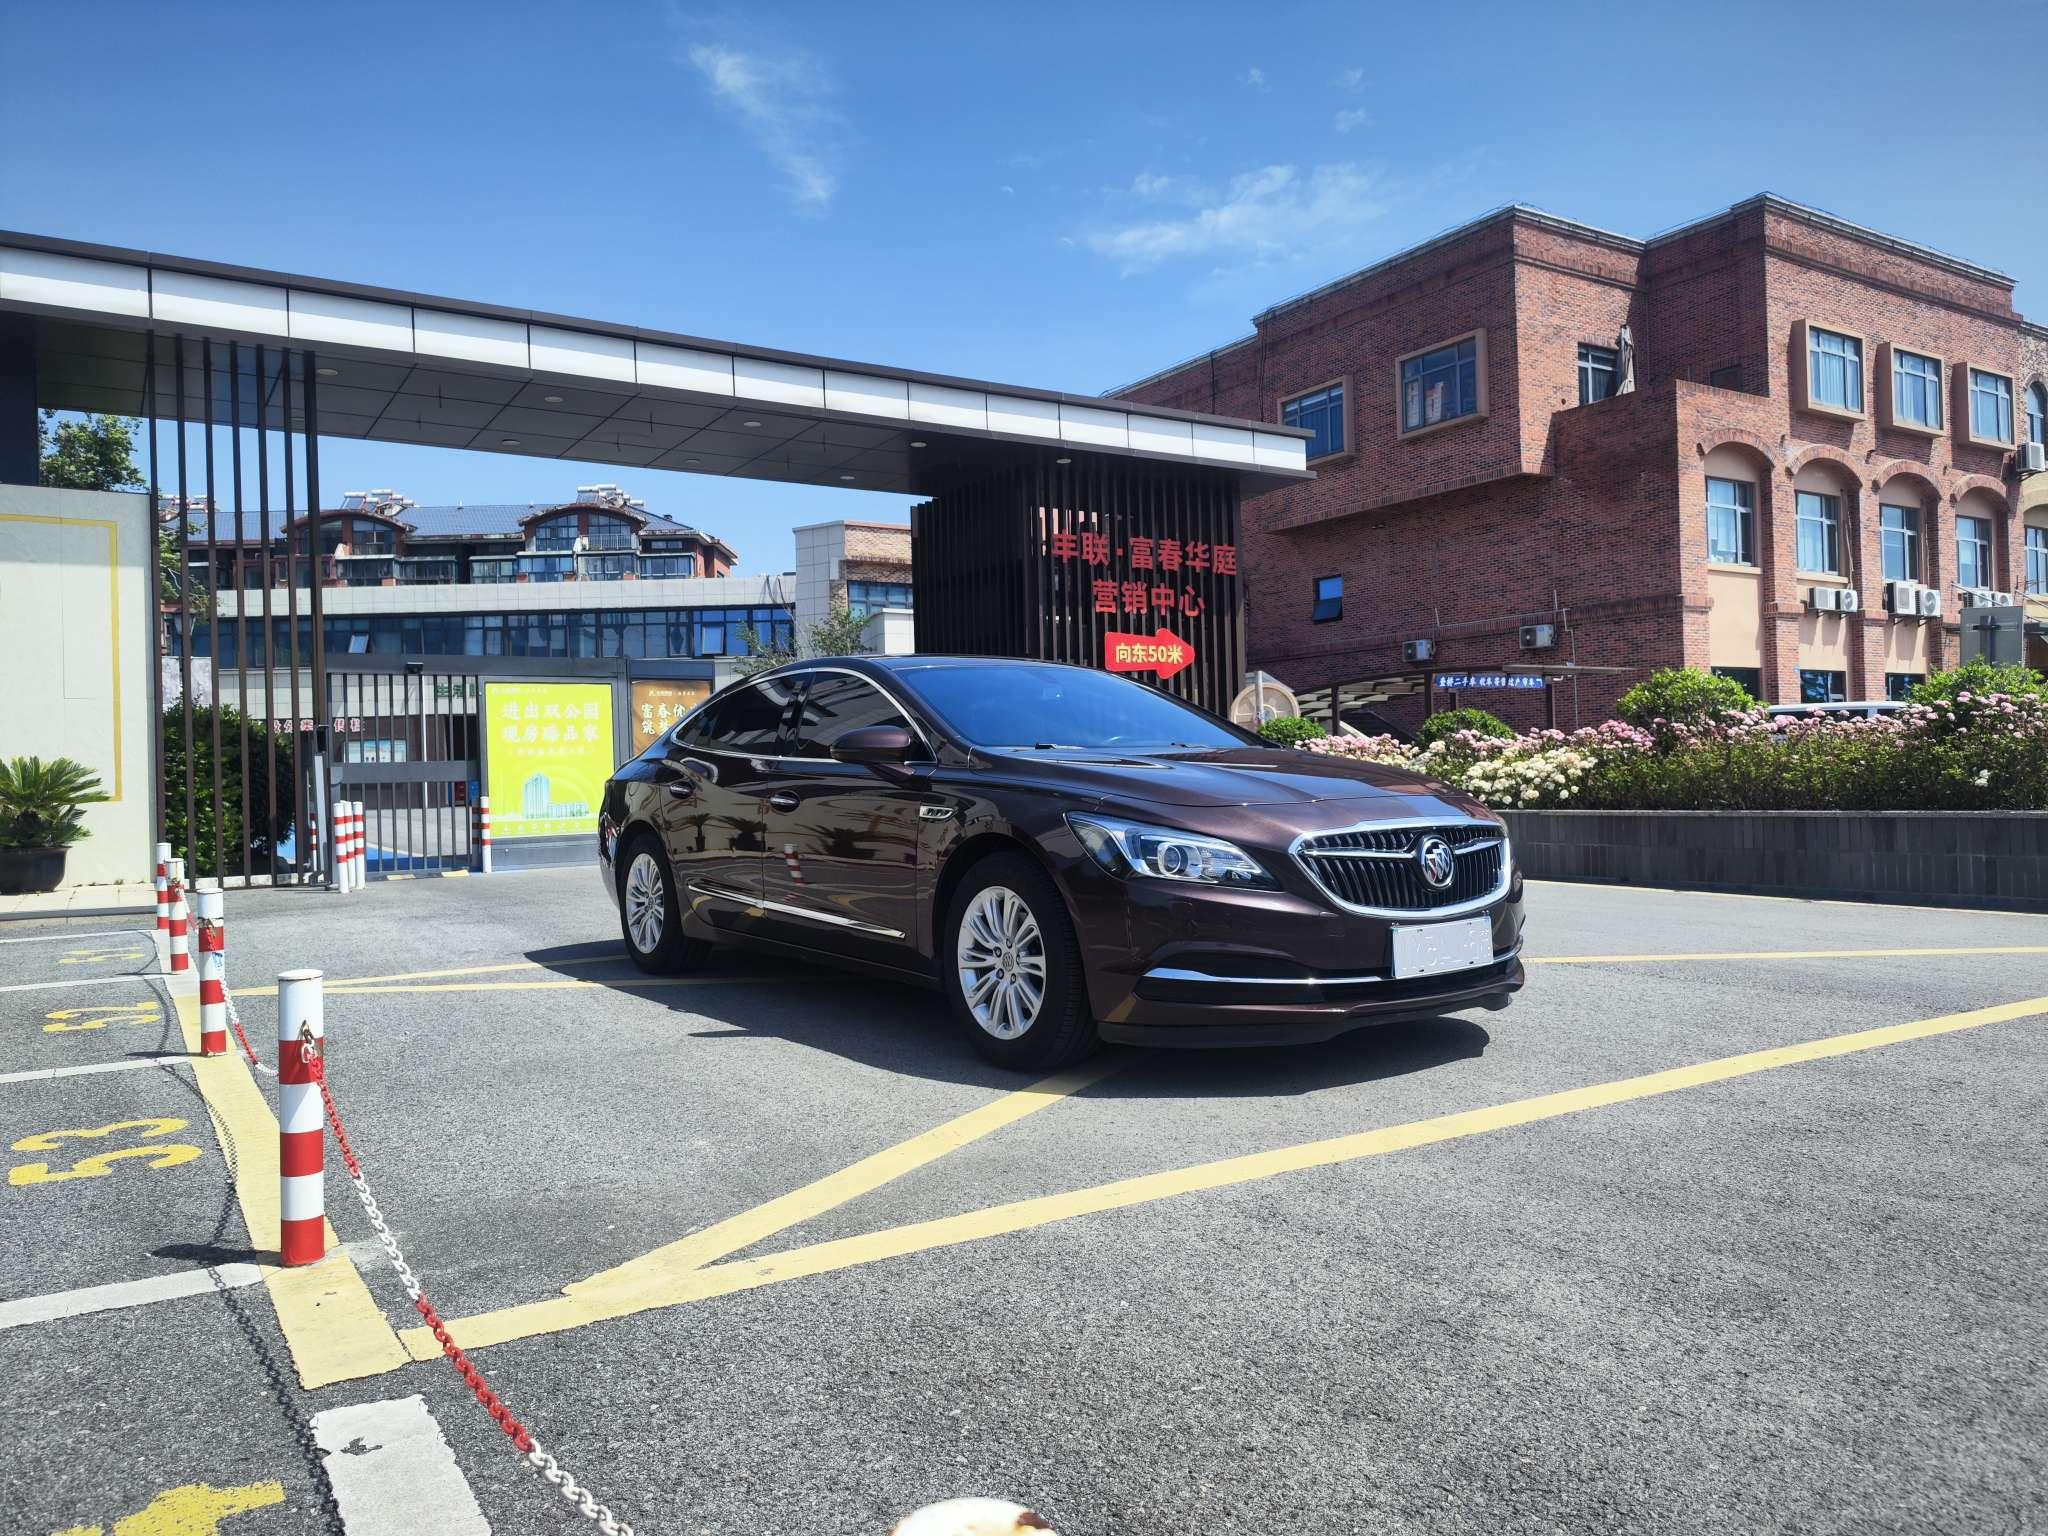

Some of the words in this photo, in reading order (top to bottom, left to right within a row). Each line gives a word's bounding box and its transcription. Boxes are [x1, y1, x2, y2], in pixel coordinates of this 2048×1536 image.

[1050, 529, 1237, 576] 丰联·富春华庭
[1092, 579, 1206, 617] 营销中心
[1115, 642, 1184, 665] 向东50米
[42, 1001, 161, 1033] 52
[8, 1117, 202, 1186] 53
